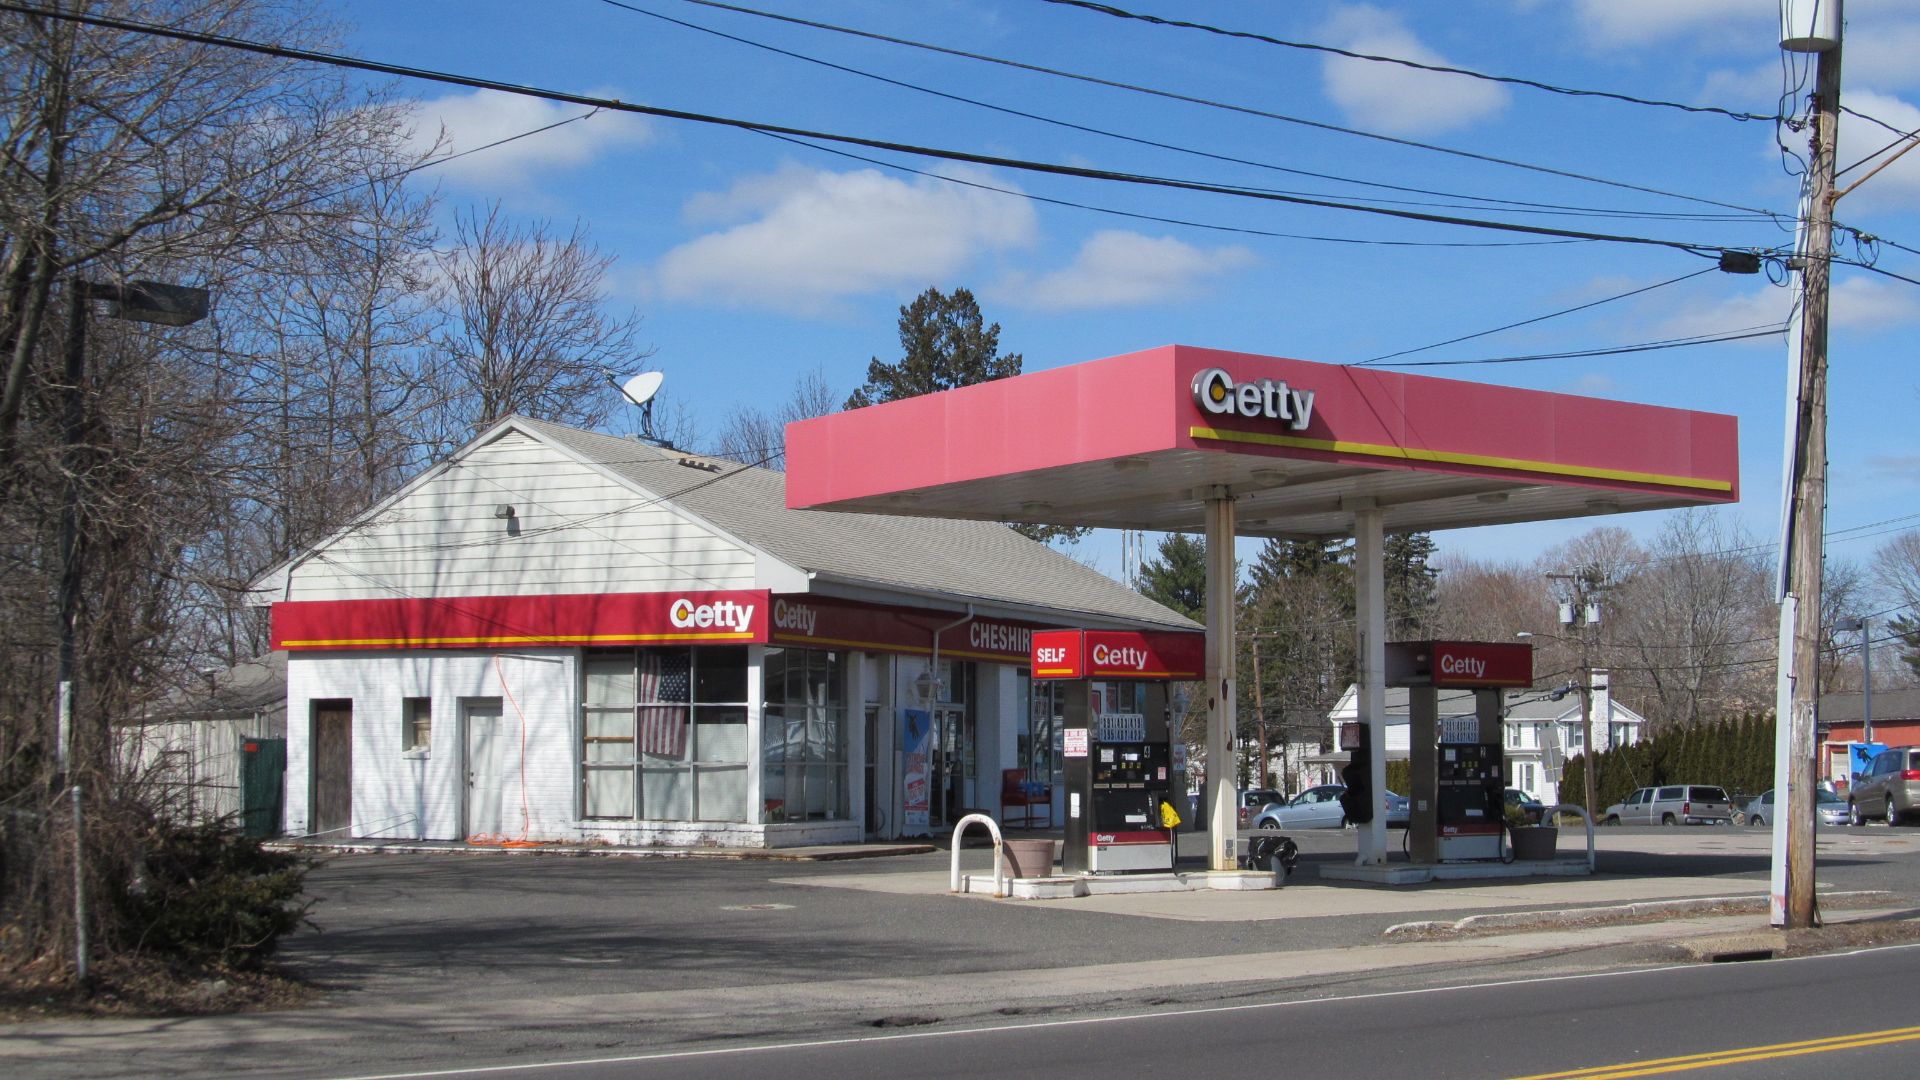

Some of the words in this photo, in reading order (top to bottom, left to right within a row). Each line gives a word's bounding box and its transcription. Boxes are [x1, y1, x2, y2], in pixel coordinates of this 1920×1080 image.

[1192, 368, 1315, 430] Getty
[670, 598, 755, 632] Getty
[774, 599, 816, 636] Getty
[970, 622, 1031, 652] CHESHIR
[1037, 648, 1065, 663] SELF
[1093, 644, 1147, 670] Getty
[1441, 654, 1485, 678] Getty
[1096, 834, 1115, 843] Getty
